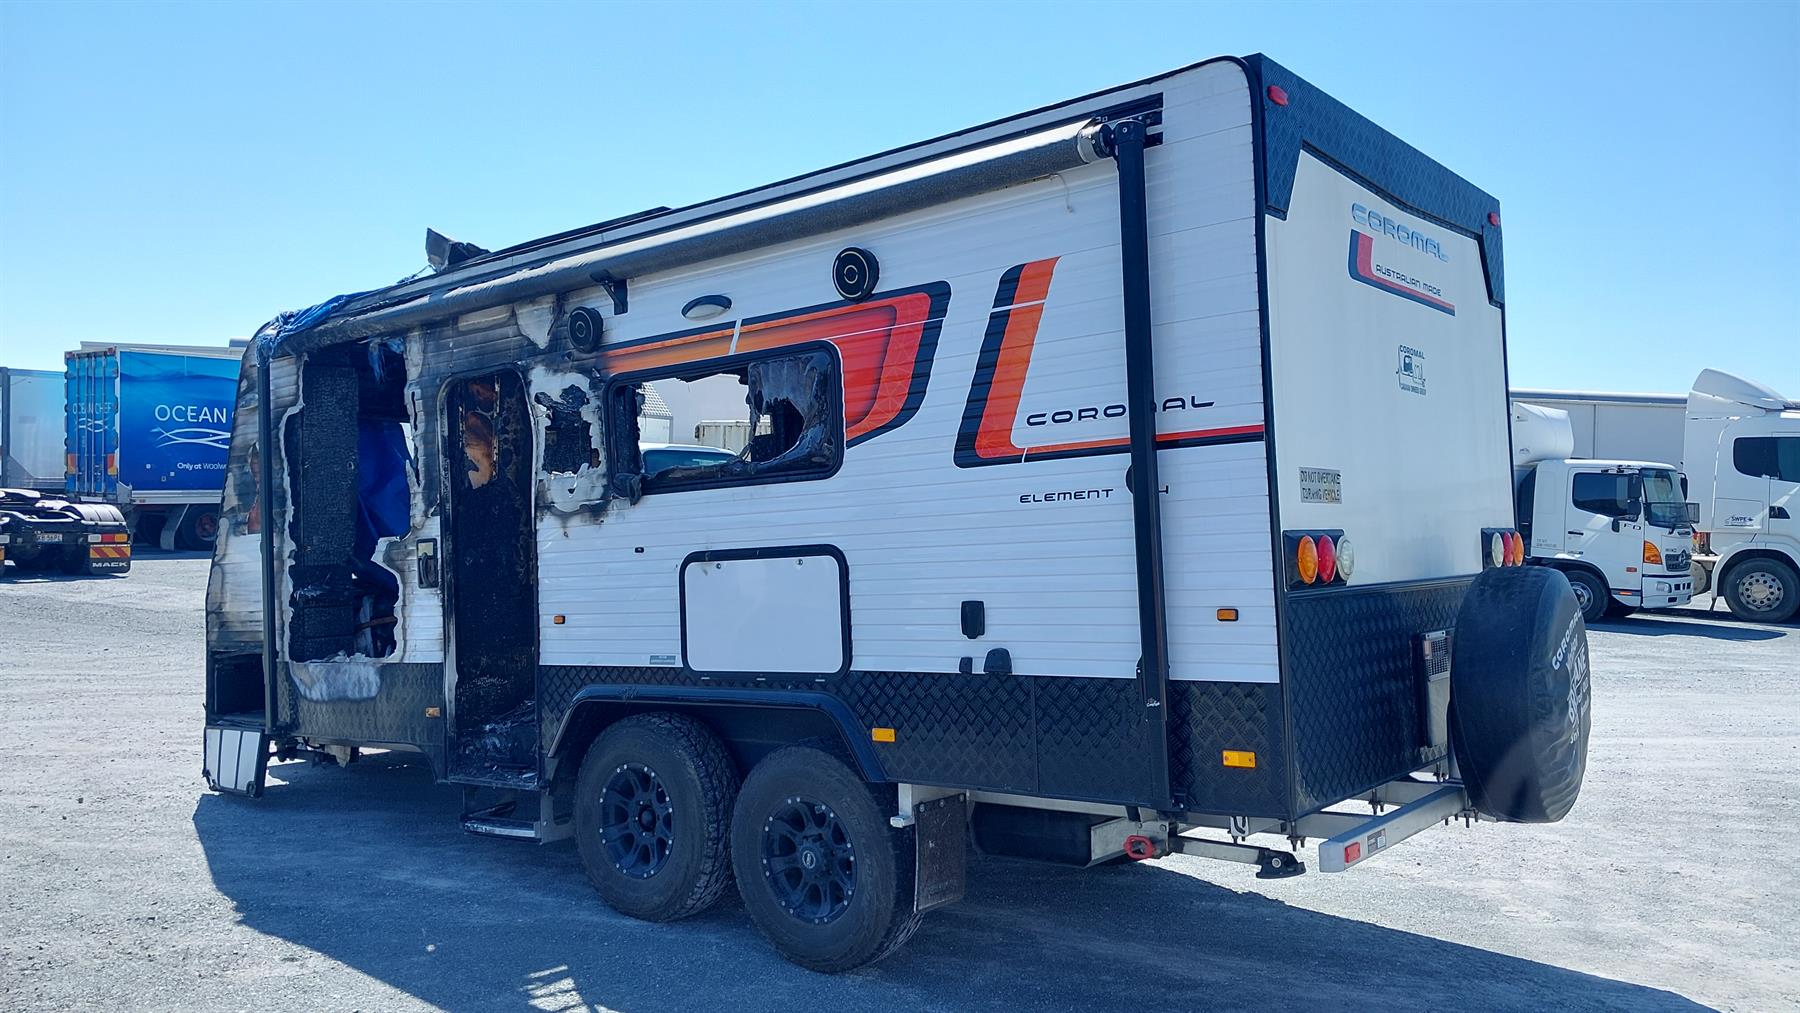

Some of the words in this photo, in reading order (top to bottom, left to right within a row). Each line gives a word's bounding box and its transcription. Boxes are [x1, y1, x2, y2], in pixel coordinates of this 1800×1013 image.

[1351, 202, 1449, 264] COROMAL
[1375, 264, 1421, 288] AUSTRALIAN
[1422, 283, 1442, 297] MADE
[154, 404, 227, 424] OCEAN
[1026, 395, 1215, 427] COROAL
[177, 462, 194, 471] Only
[1019, 488, 1114, 504] ELEMENT
